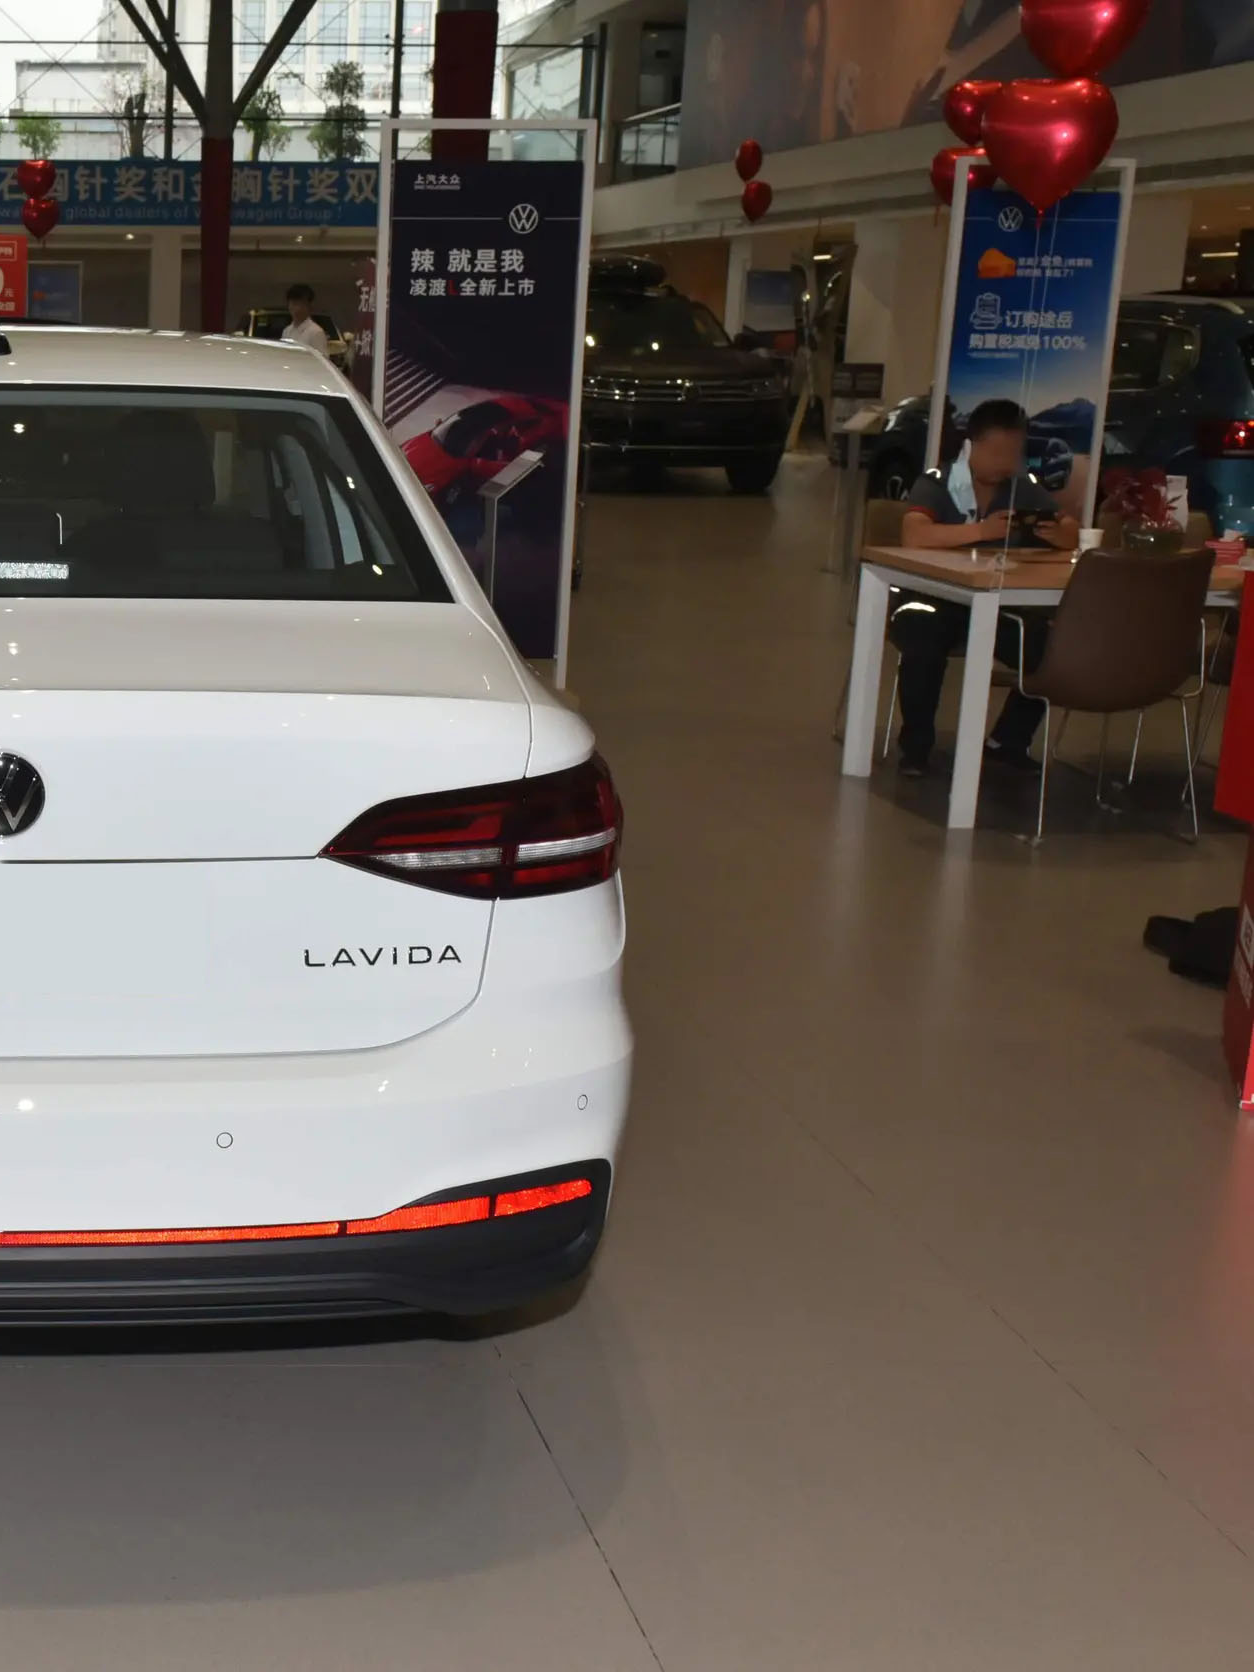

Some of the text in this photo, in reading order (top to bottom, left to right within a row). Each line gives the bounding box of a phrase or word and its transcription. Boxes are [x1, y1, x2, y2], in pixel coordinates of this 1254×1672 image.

[414, 173, 461, 184] 上汽大众
[411, 248, 524, 273] 辣 就是我
[304, 945, 462, 967] LAVIDA
